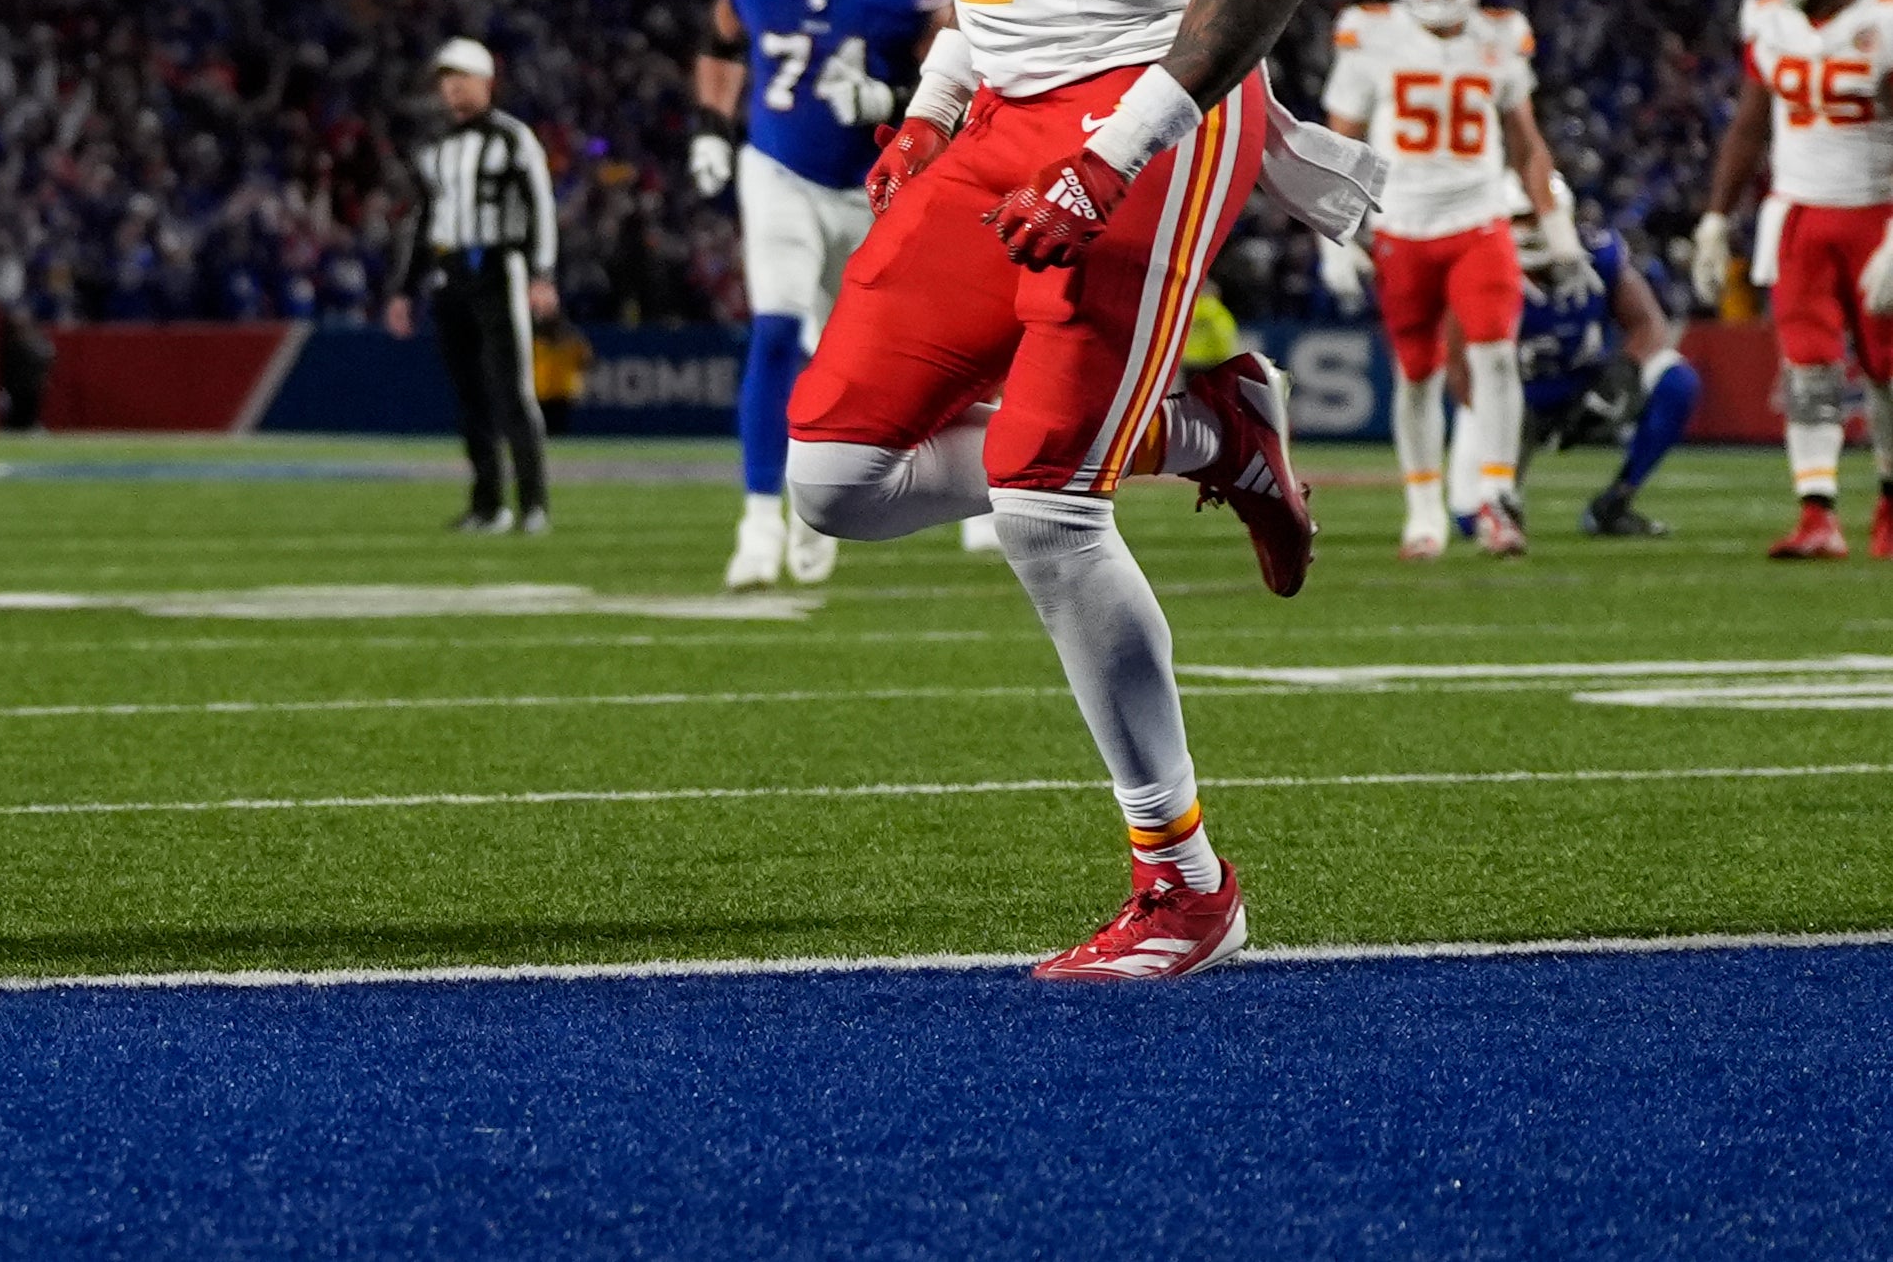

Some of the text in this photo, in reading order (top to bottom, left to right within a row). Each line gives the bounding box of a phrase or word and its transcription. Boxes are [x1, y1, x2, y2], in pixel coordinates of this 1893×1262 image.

[760, 31, 875, 124] 74
[1393, 71, 1491, 155] 56
[1774, 57, 1875, 125] 95
[1060, 166, 1099, 220] adidas
